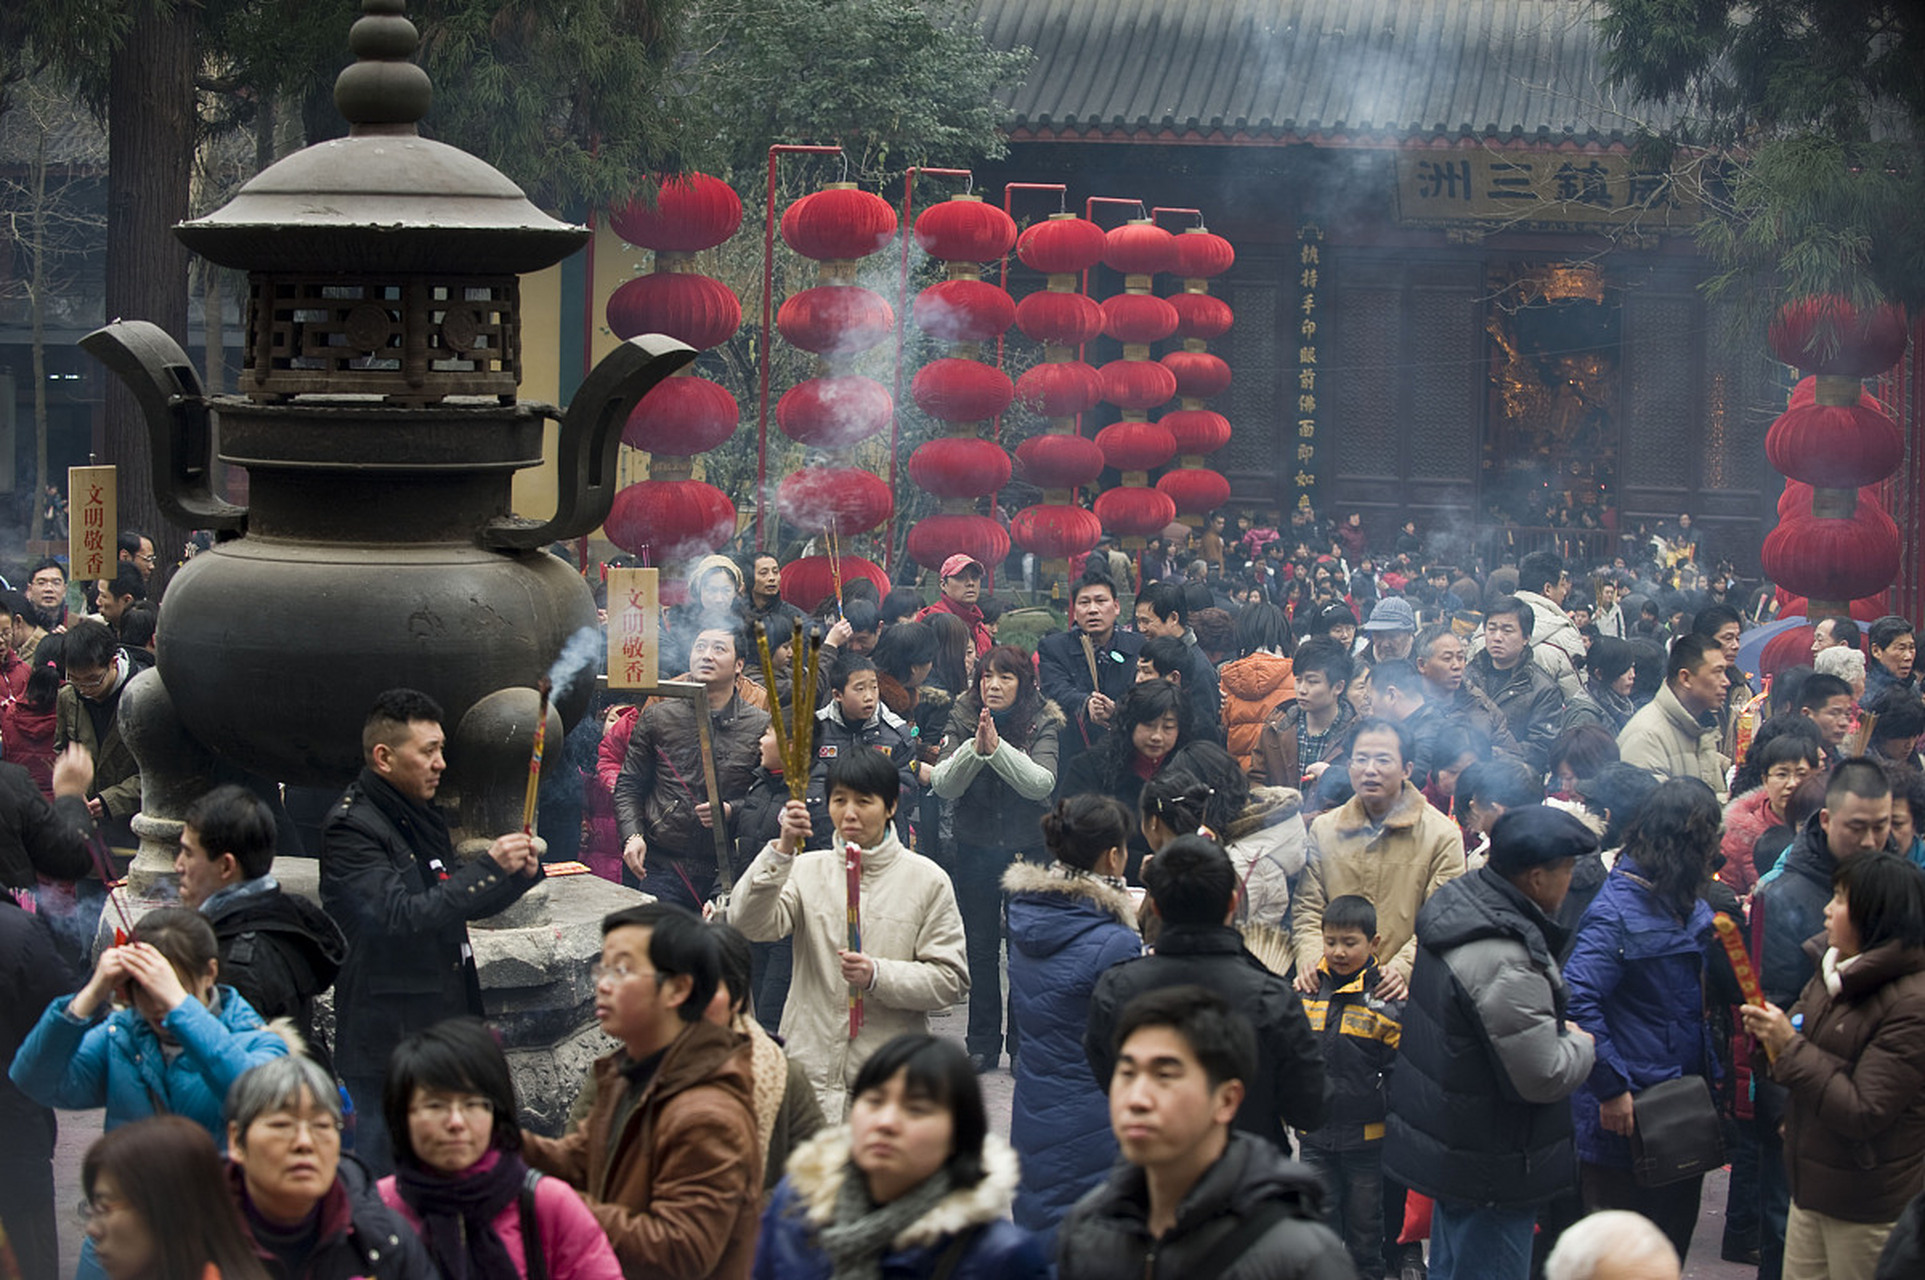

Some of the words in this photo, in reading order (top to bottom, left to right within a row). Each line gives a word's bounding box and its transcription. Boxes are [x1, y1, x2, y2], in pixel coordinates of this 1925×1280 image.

[84, 484, 103, 574] 文明敬香
[623, 588, 644, 683] 文明敬香
